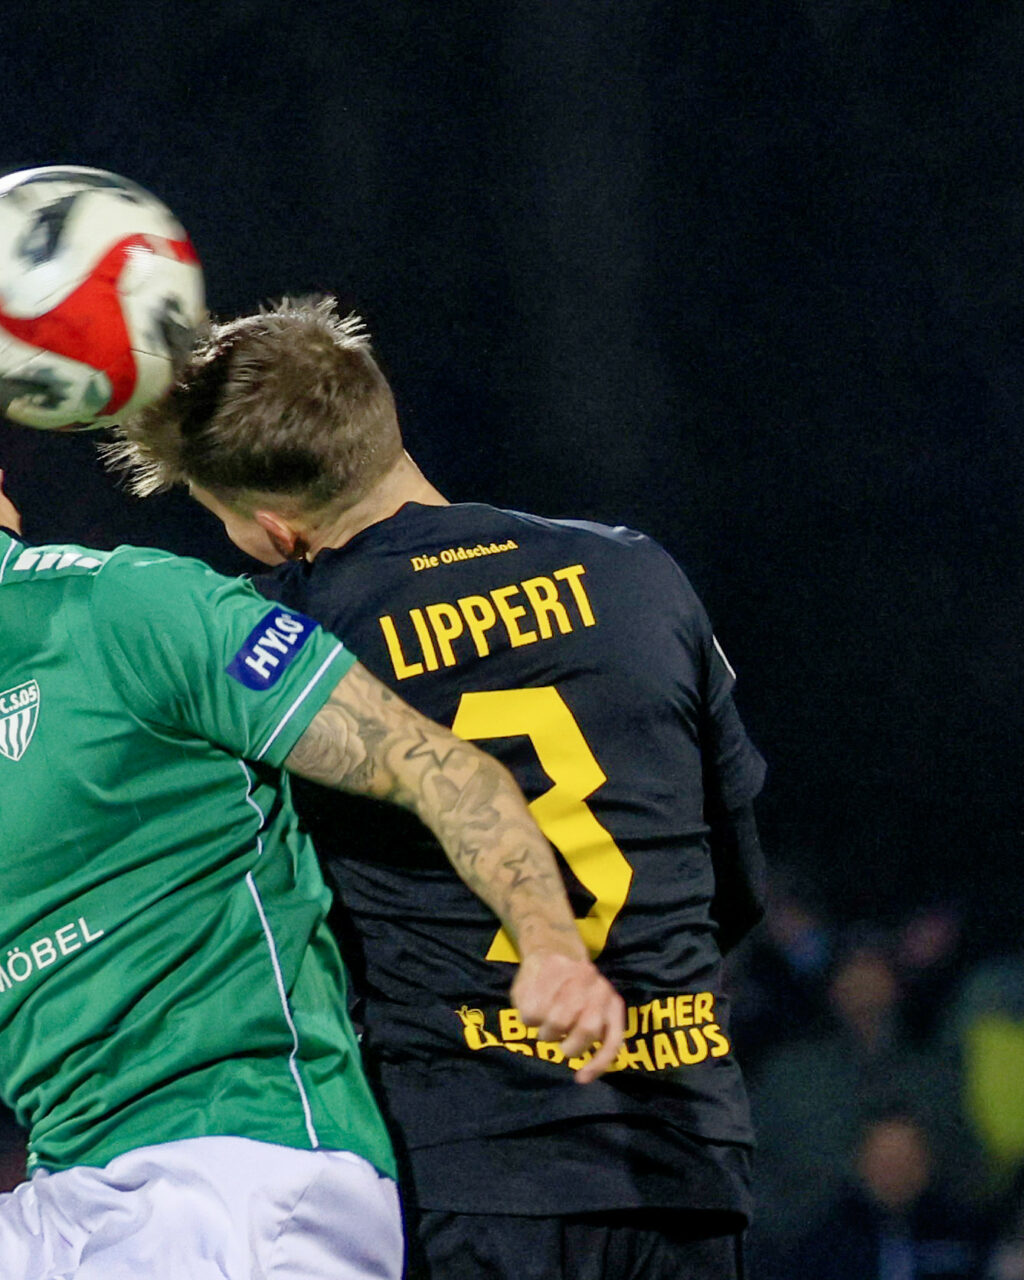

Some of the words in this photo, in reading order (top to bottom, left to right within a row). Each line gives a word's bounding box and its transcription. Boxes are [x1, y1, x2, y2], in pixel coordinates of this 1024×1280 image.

[411, 555, 439, 571] Die
[379, 564, 596, 680] LIPPERT
[451, 686, 634, 962] 3
